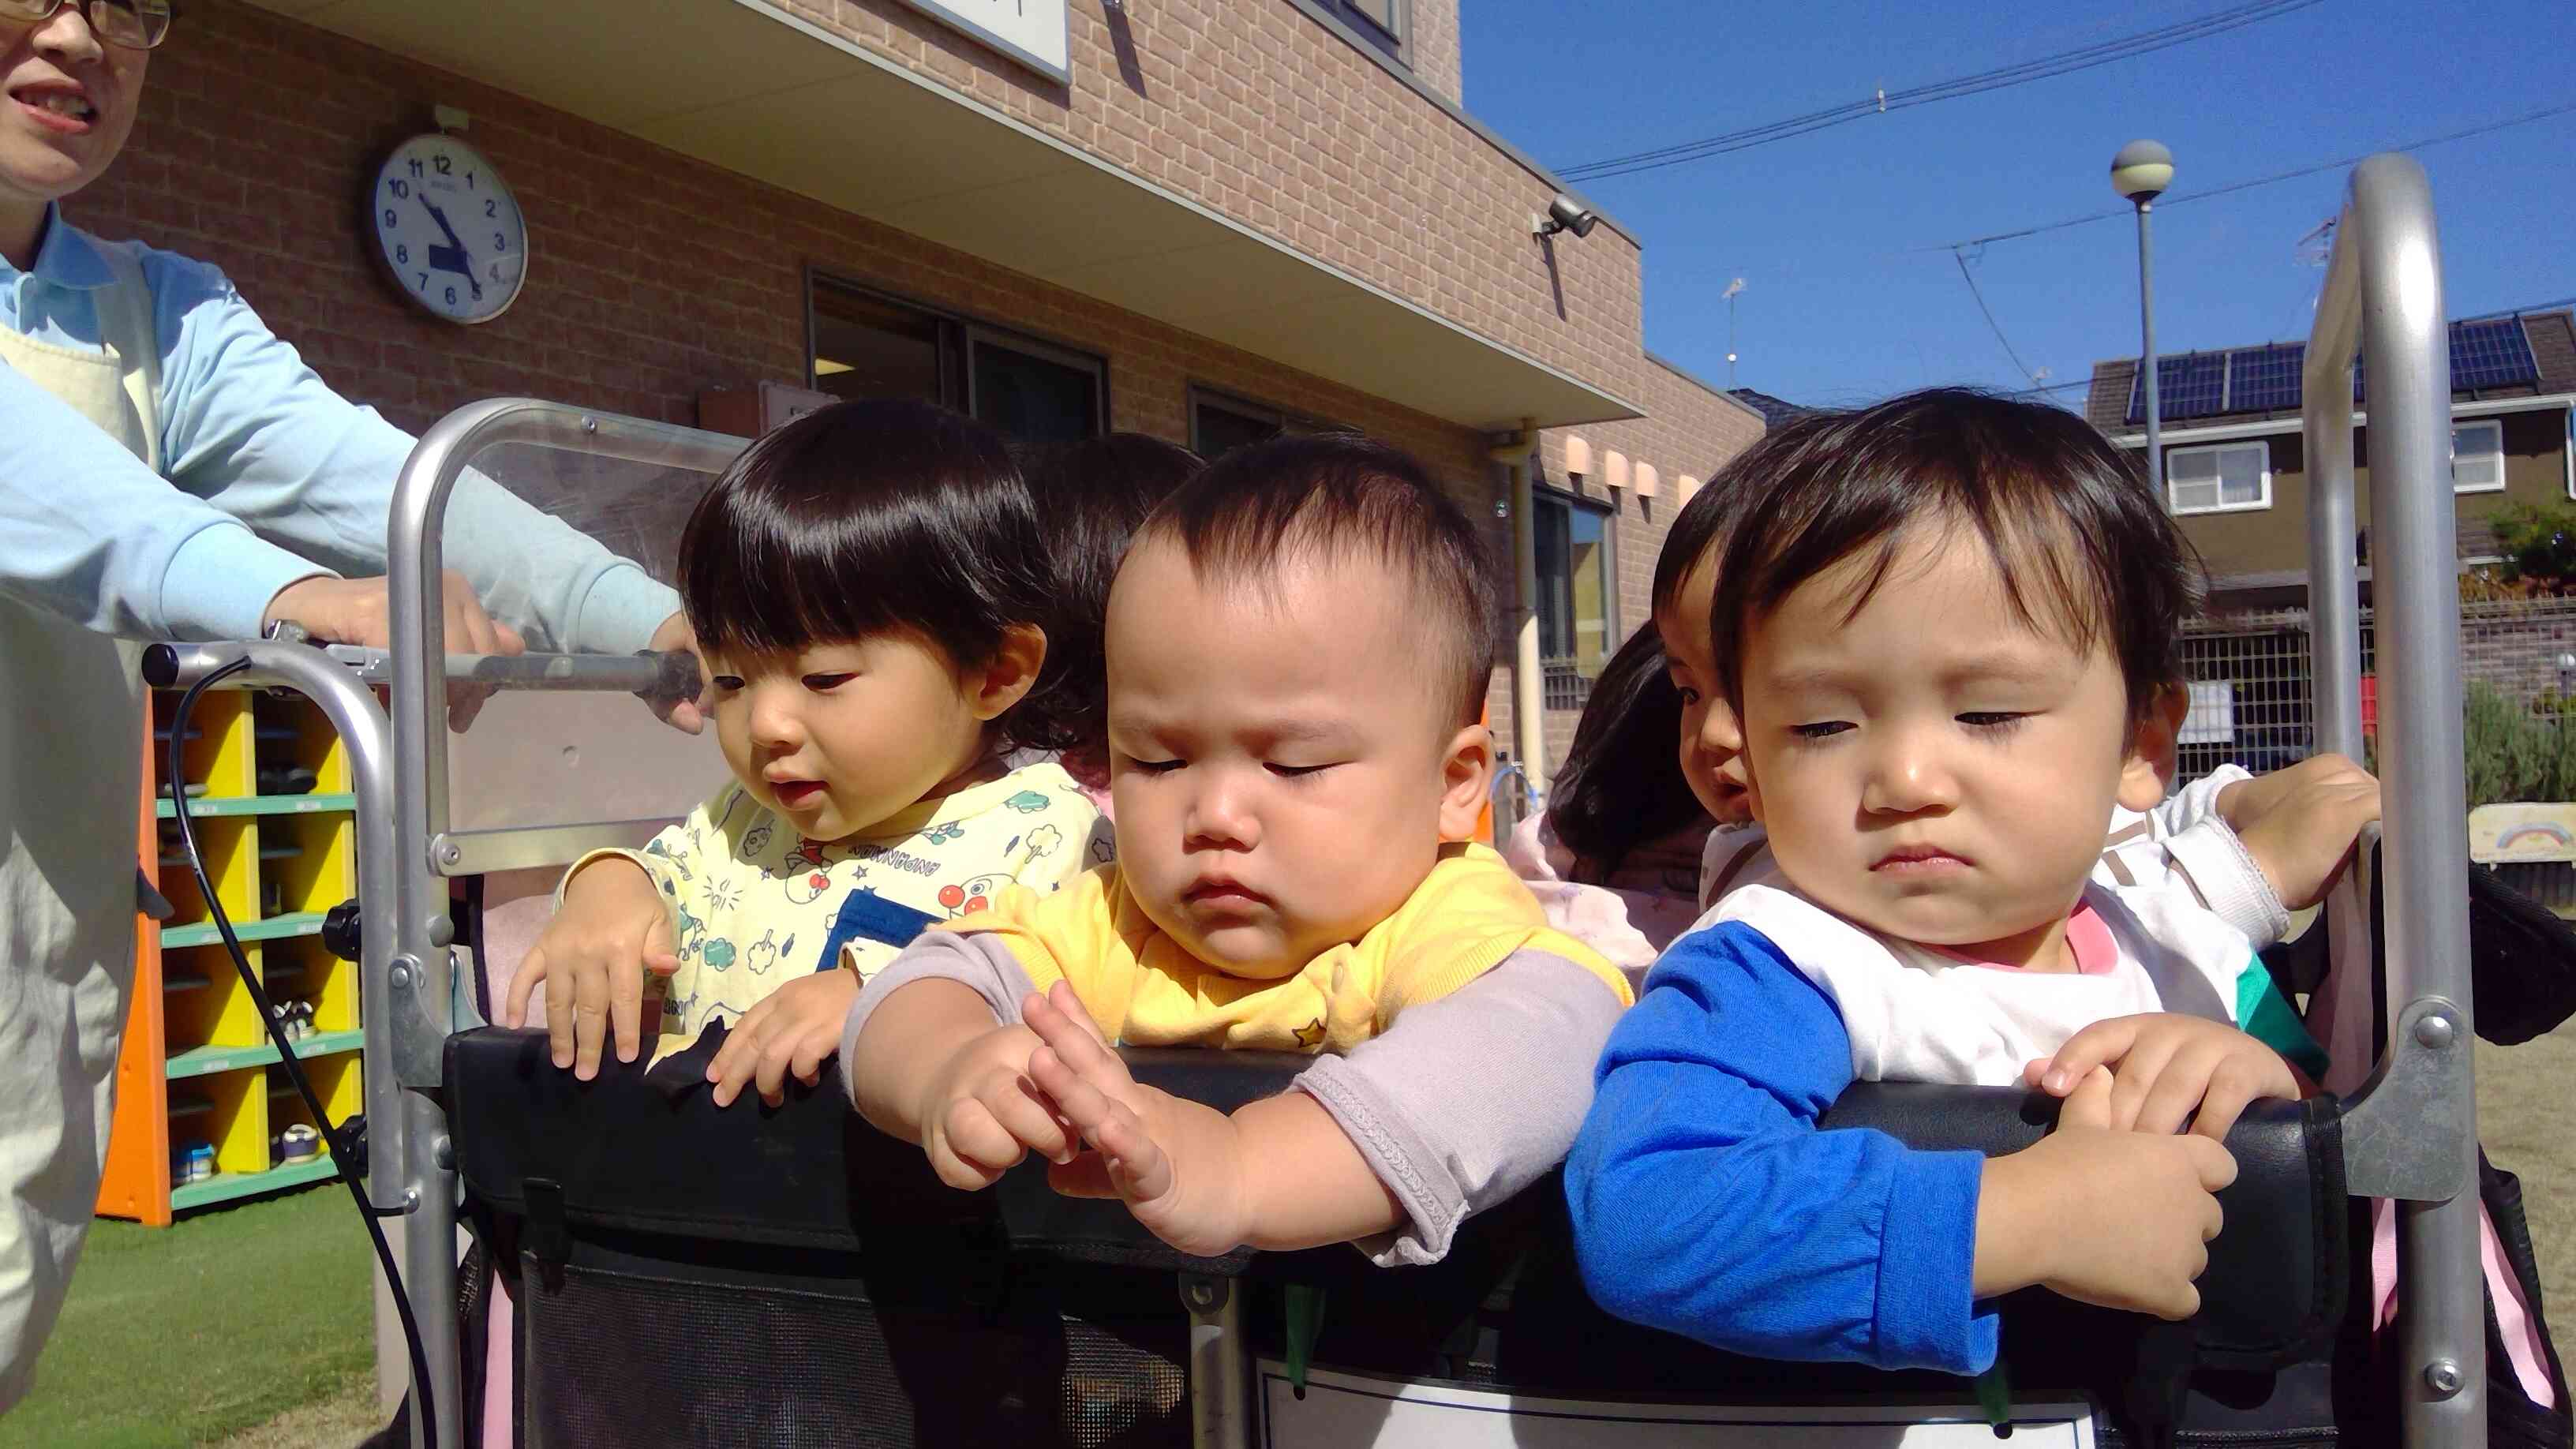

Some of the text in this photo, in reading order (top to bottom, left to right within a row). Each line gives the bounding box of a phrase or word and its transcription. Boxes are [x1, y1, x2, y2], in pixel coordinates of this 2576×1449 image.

[408, 159, 425, 179] 11
[432, 155, 452, 176] 12
[388, 178, 410, 200] 10
[466, 170, 474, 190] 1
[384, 209, 398, 229] 9
[485, 199, 497, 219] 2
[494, 233, 506, 252] 3
[396, 244, 409, 265] 8
[417, 271, 429, 291] 7
[489, 263, 500, 283] 4
[444, 286, 458, 306] 6
